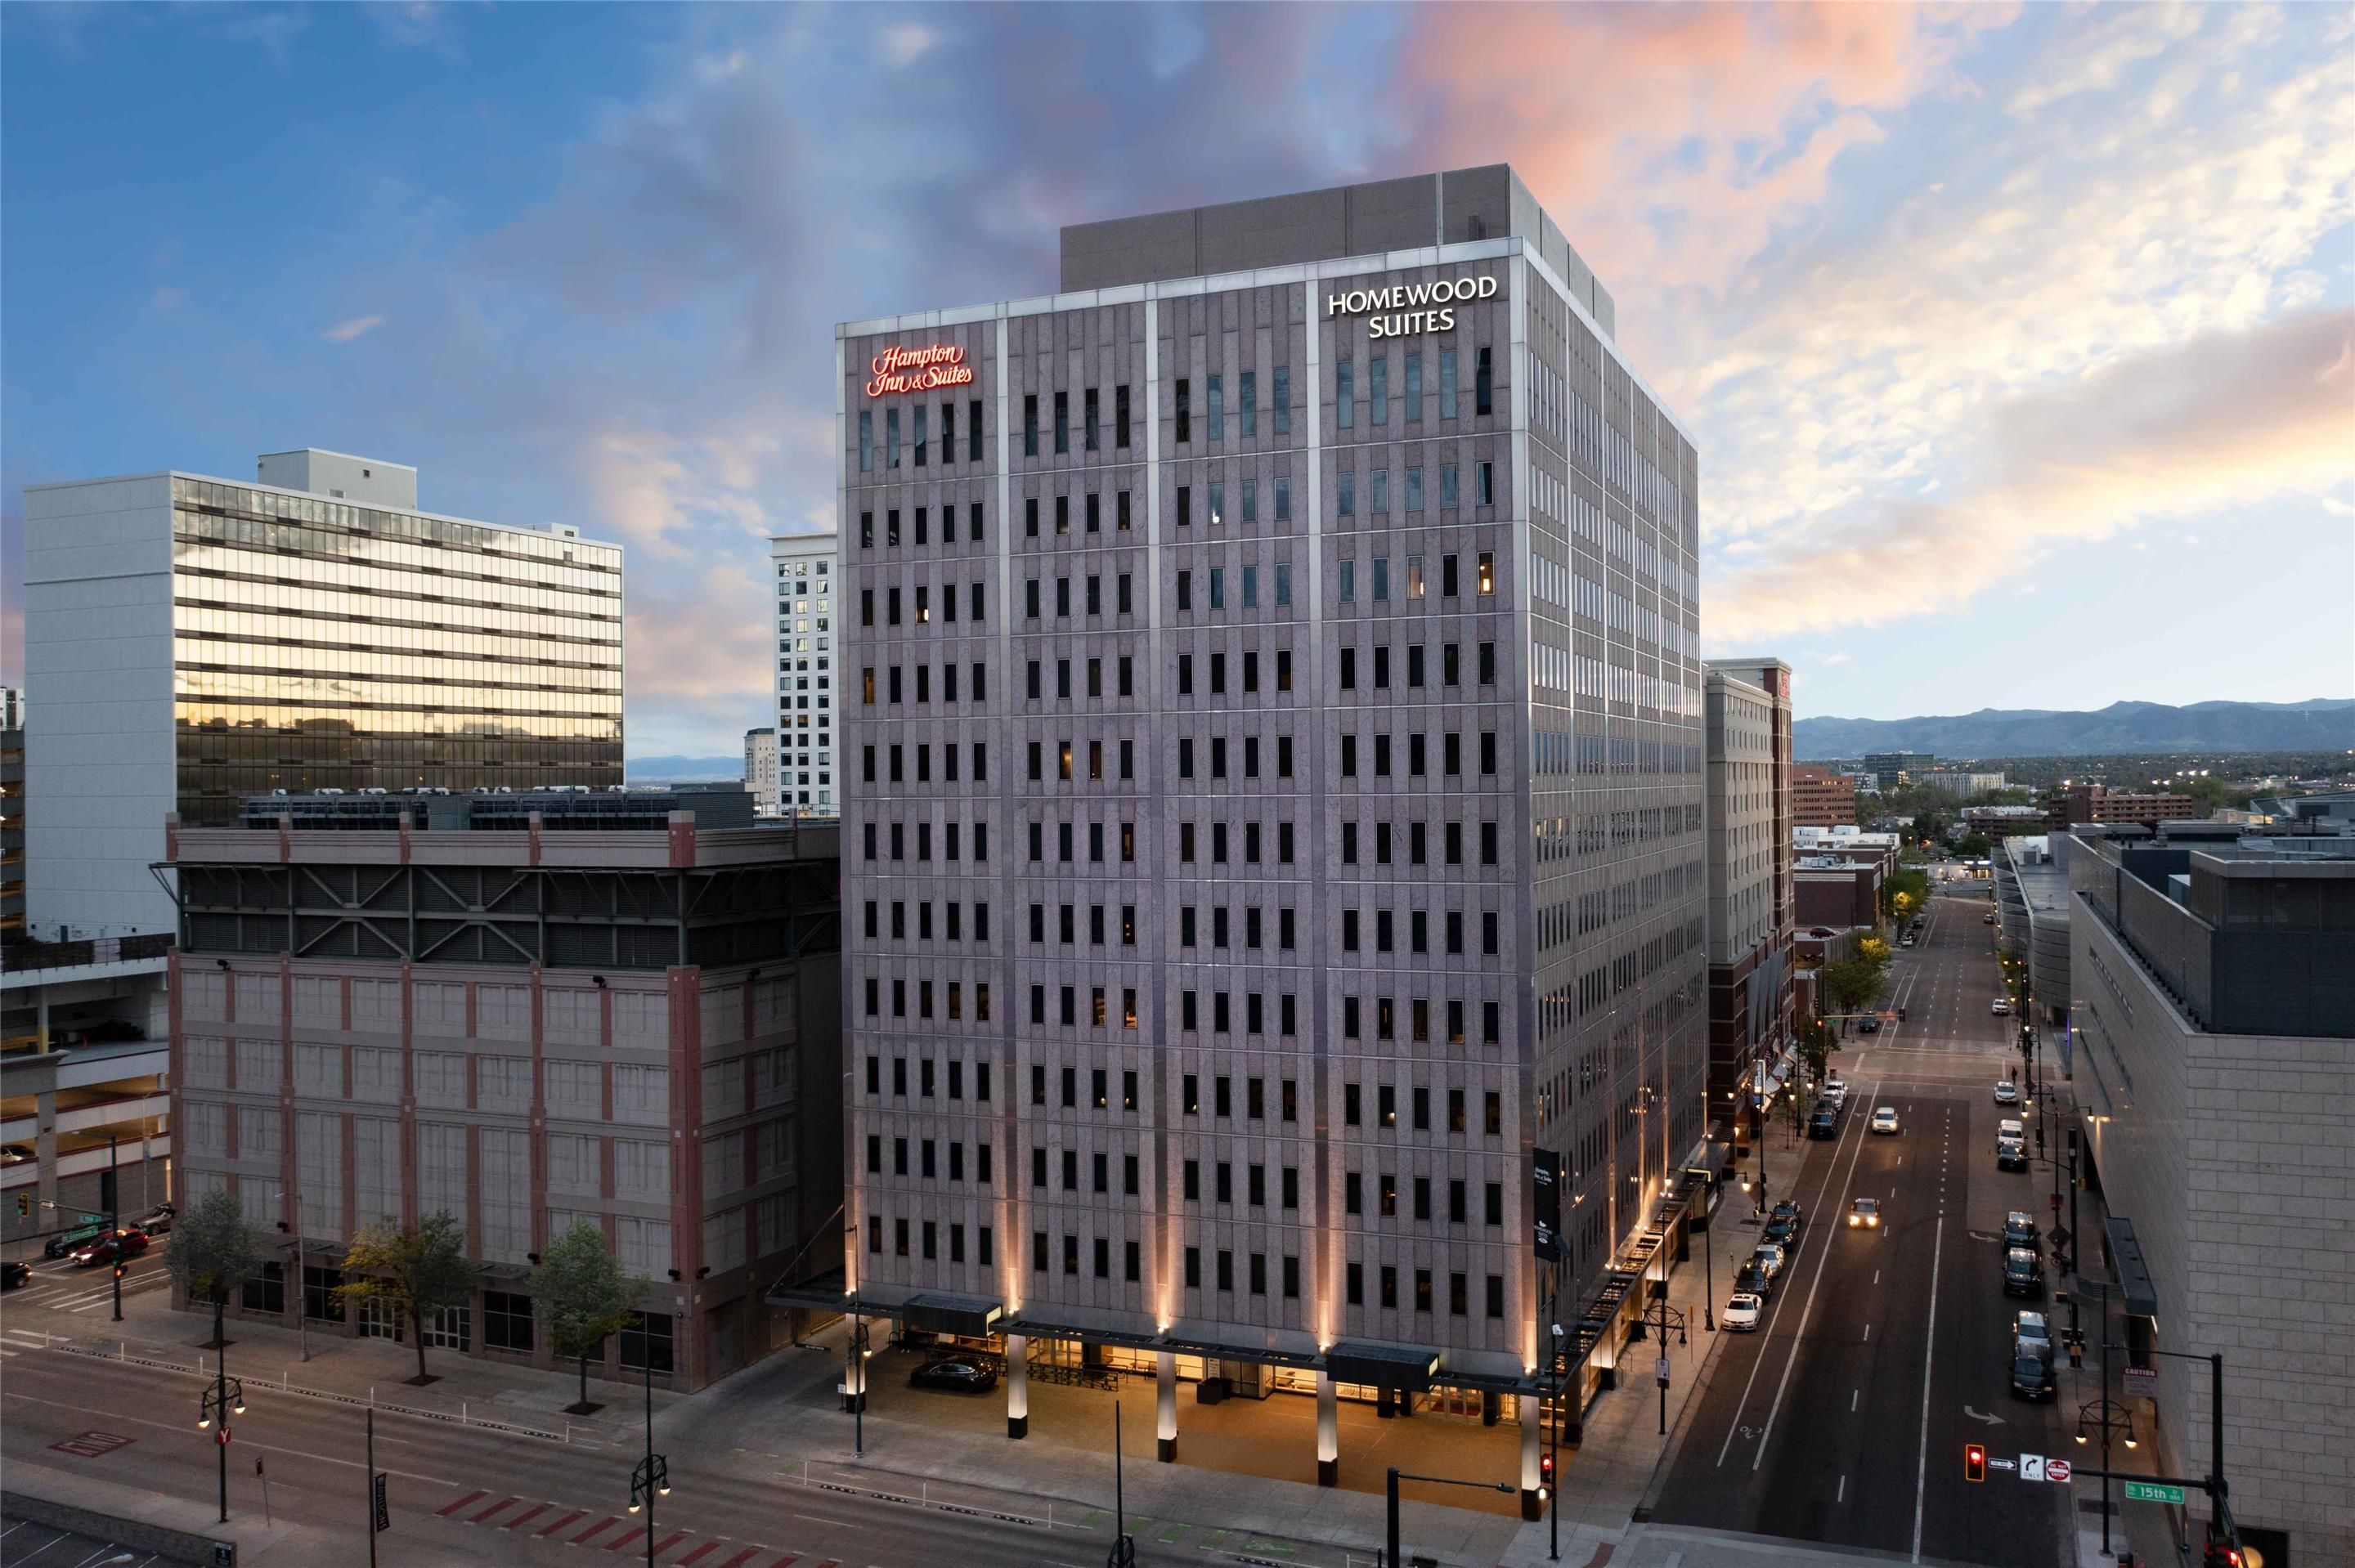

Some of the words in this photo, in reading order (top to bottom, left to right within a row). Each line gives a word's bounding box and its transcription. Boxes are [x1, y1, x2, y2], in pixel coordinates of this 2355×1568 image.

[1329, 276, 1497, 315] HOMEWOOD
[1369, 308, 1455, 338] SUITES
[872, 344, 964, 375] Hampton
[867, 373, 912, 396] Inn
[912, 374, 924, 390] &
[922, 365, 972, 388] Suites
[2125, 1369, 2155, 1377] CAUTION
[2140, 1486, 2166, 1499] 15th
